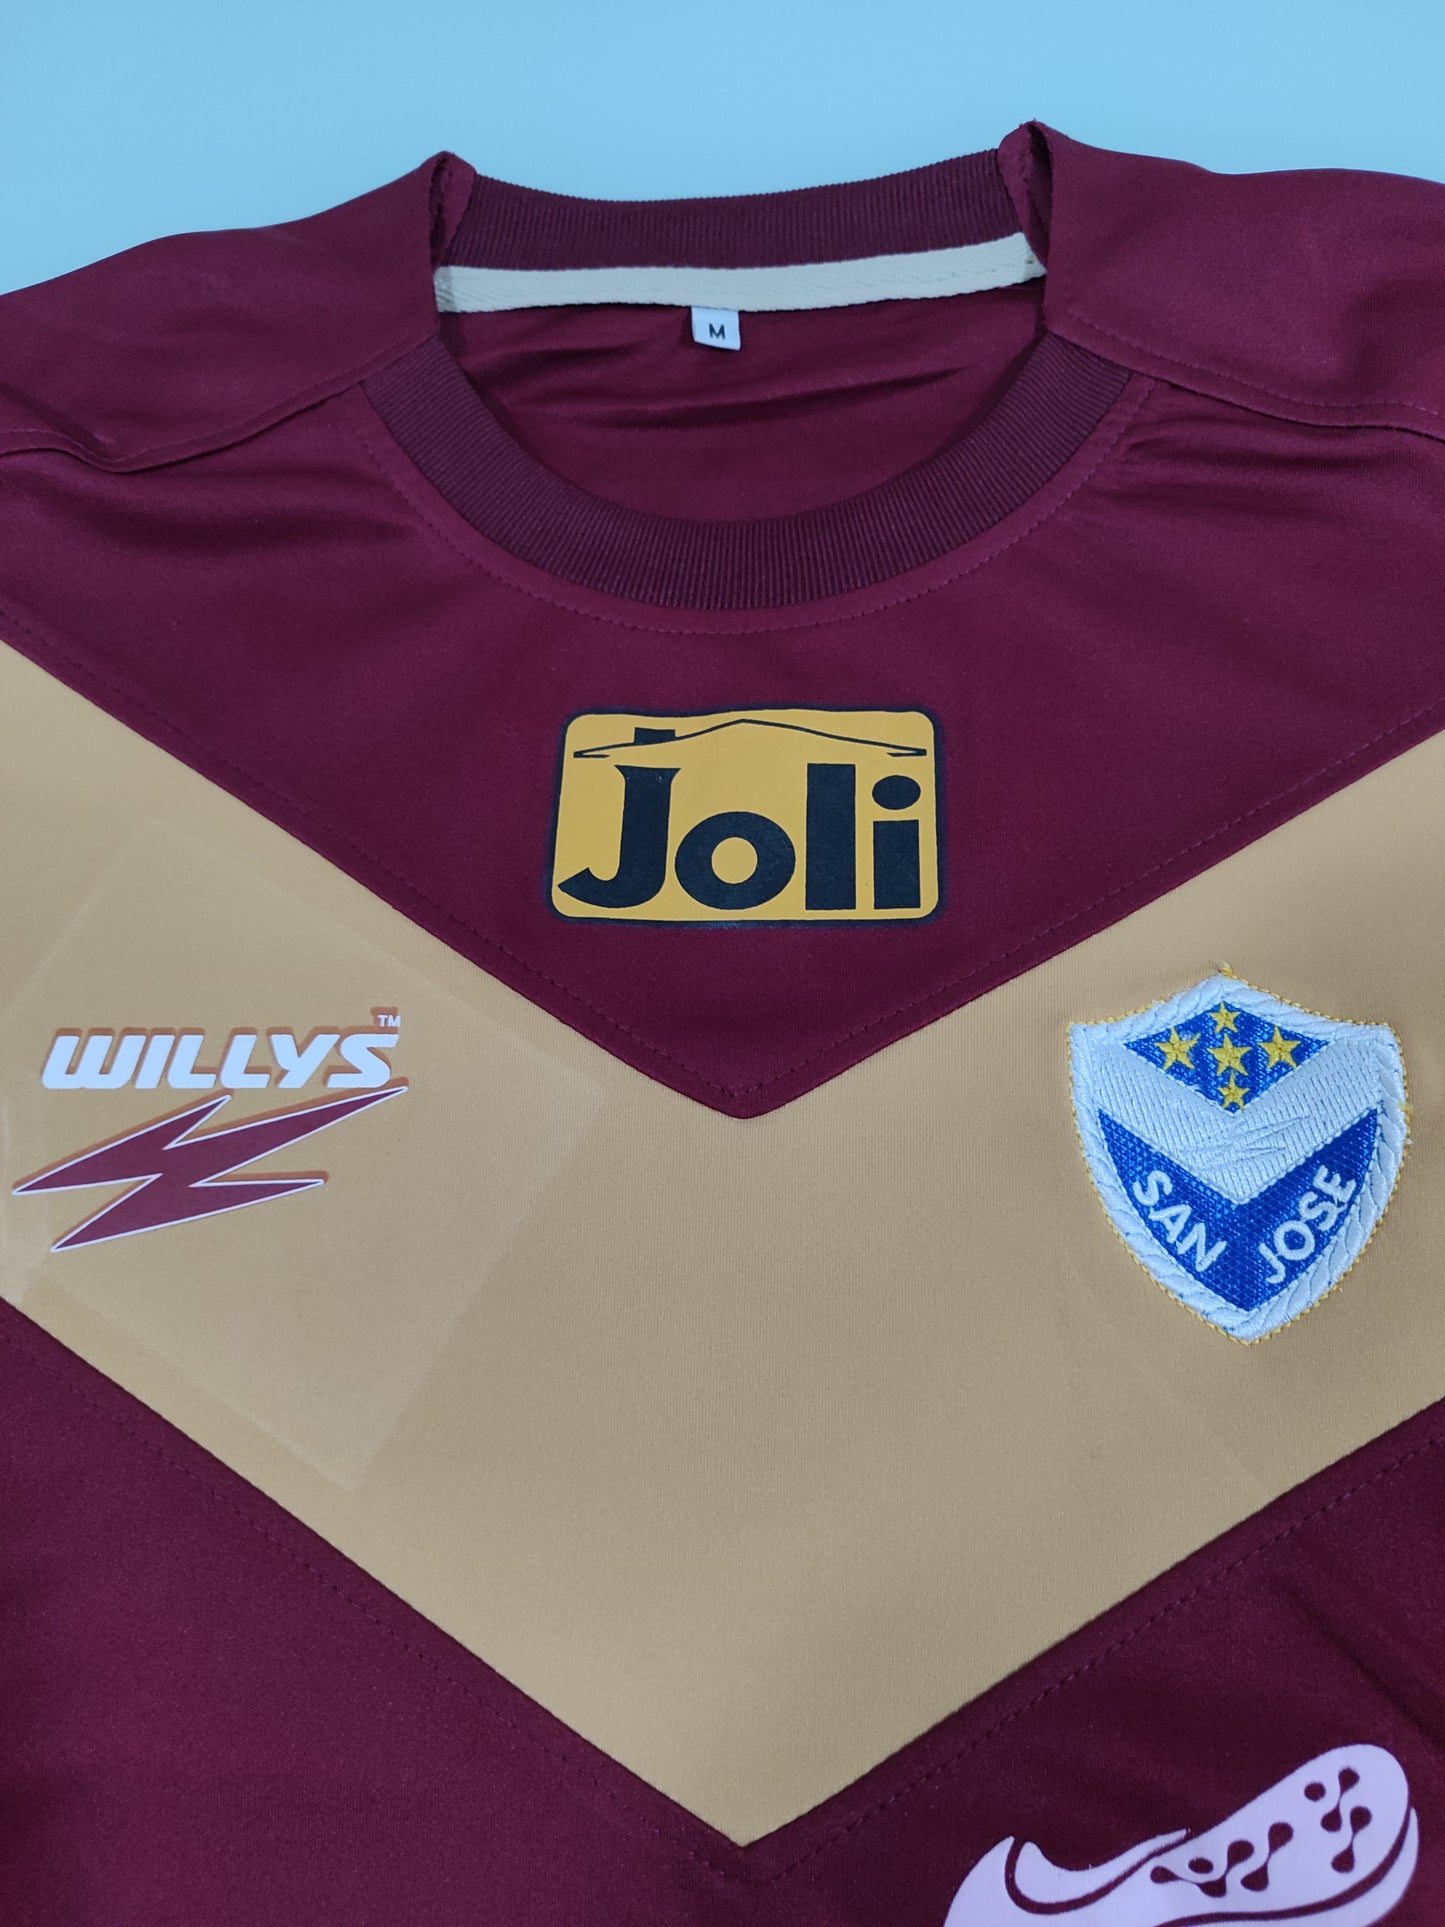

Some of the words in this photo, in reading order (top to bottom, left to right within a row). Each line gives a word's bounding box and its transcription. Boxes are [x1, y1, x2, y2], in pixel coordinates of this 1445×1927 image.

[708, 323, 726, 340] M
[557, 763, 921, 911] Joli
[42, 1031, 400, 1089] WILLYS
[1132, 1169, 1228, 1273] SAN
[1258, 1164, 1358, 1285] JOSE
